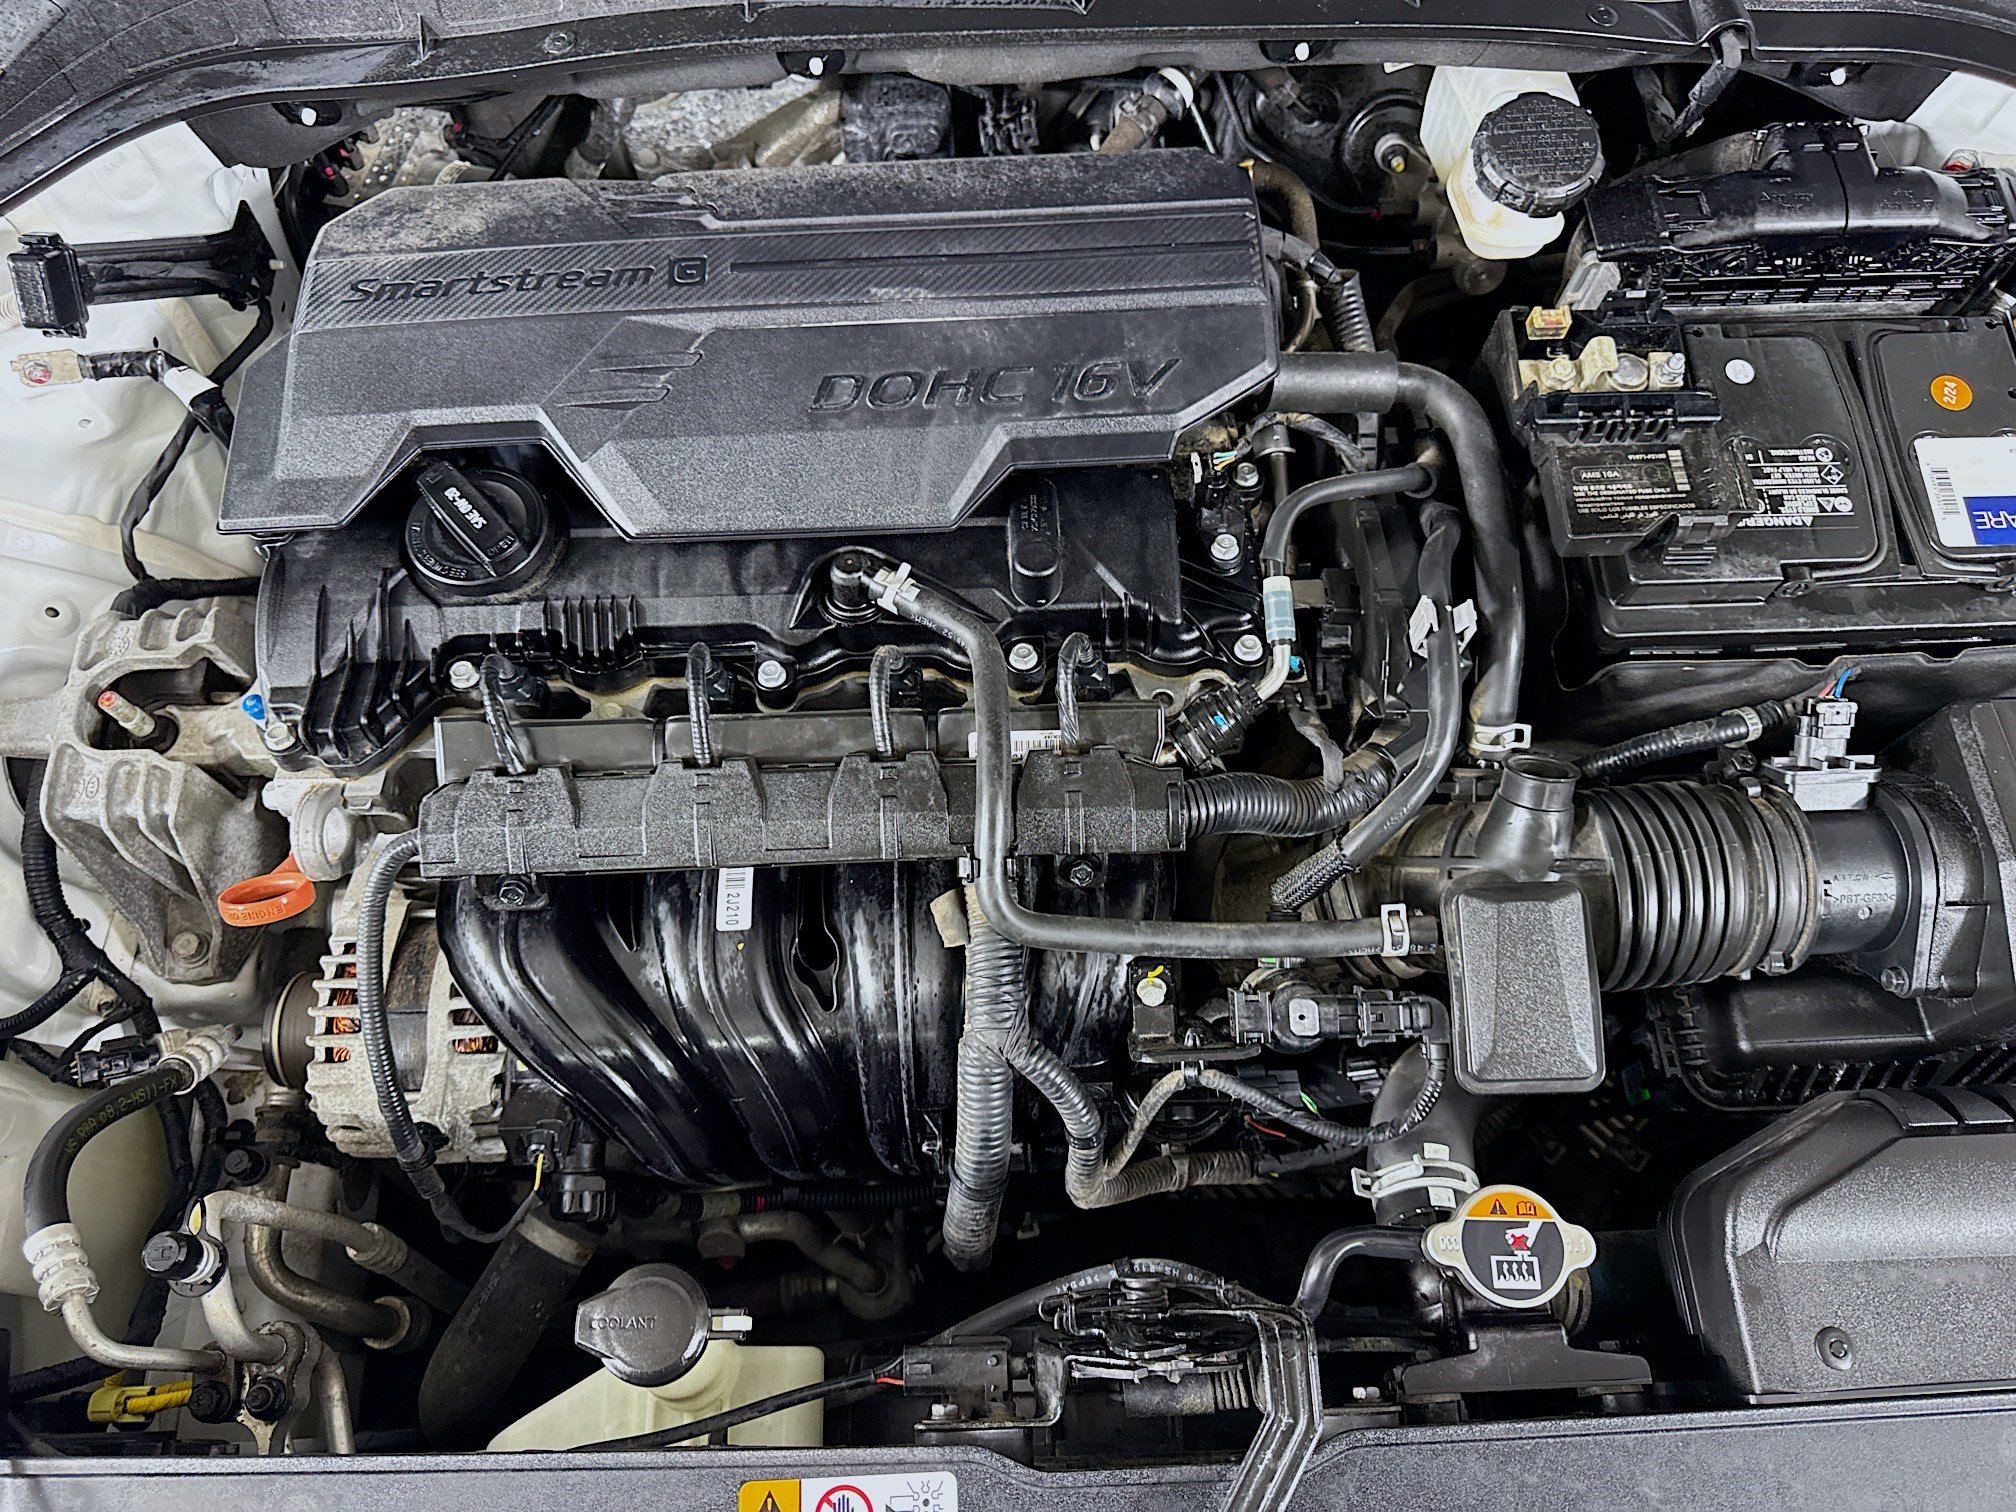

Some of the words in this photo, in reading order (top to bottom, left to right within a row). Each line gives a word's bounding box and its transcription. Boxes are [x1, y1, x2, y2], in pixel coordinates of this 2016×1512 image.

[346, 266, 656, 302] Smartstream
[809, 366, 1034, 412] DOHC
[1053, 358, 1182, 402] 16V
[1943, 381, 1957, 405] 2/24
[1582, 471, 1601, 479] AMS
[1602, 470, 1620, 479] 10A
[466, 506, 488, 530] SAE
[241, 904, 286, 921] ENGINE
[725, 892, 741, 926] 2J210
[589, 1315, 657, 1330] COOLANT
